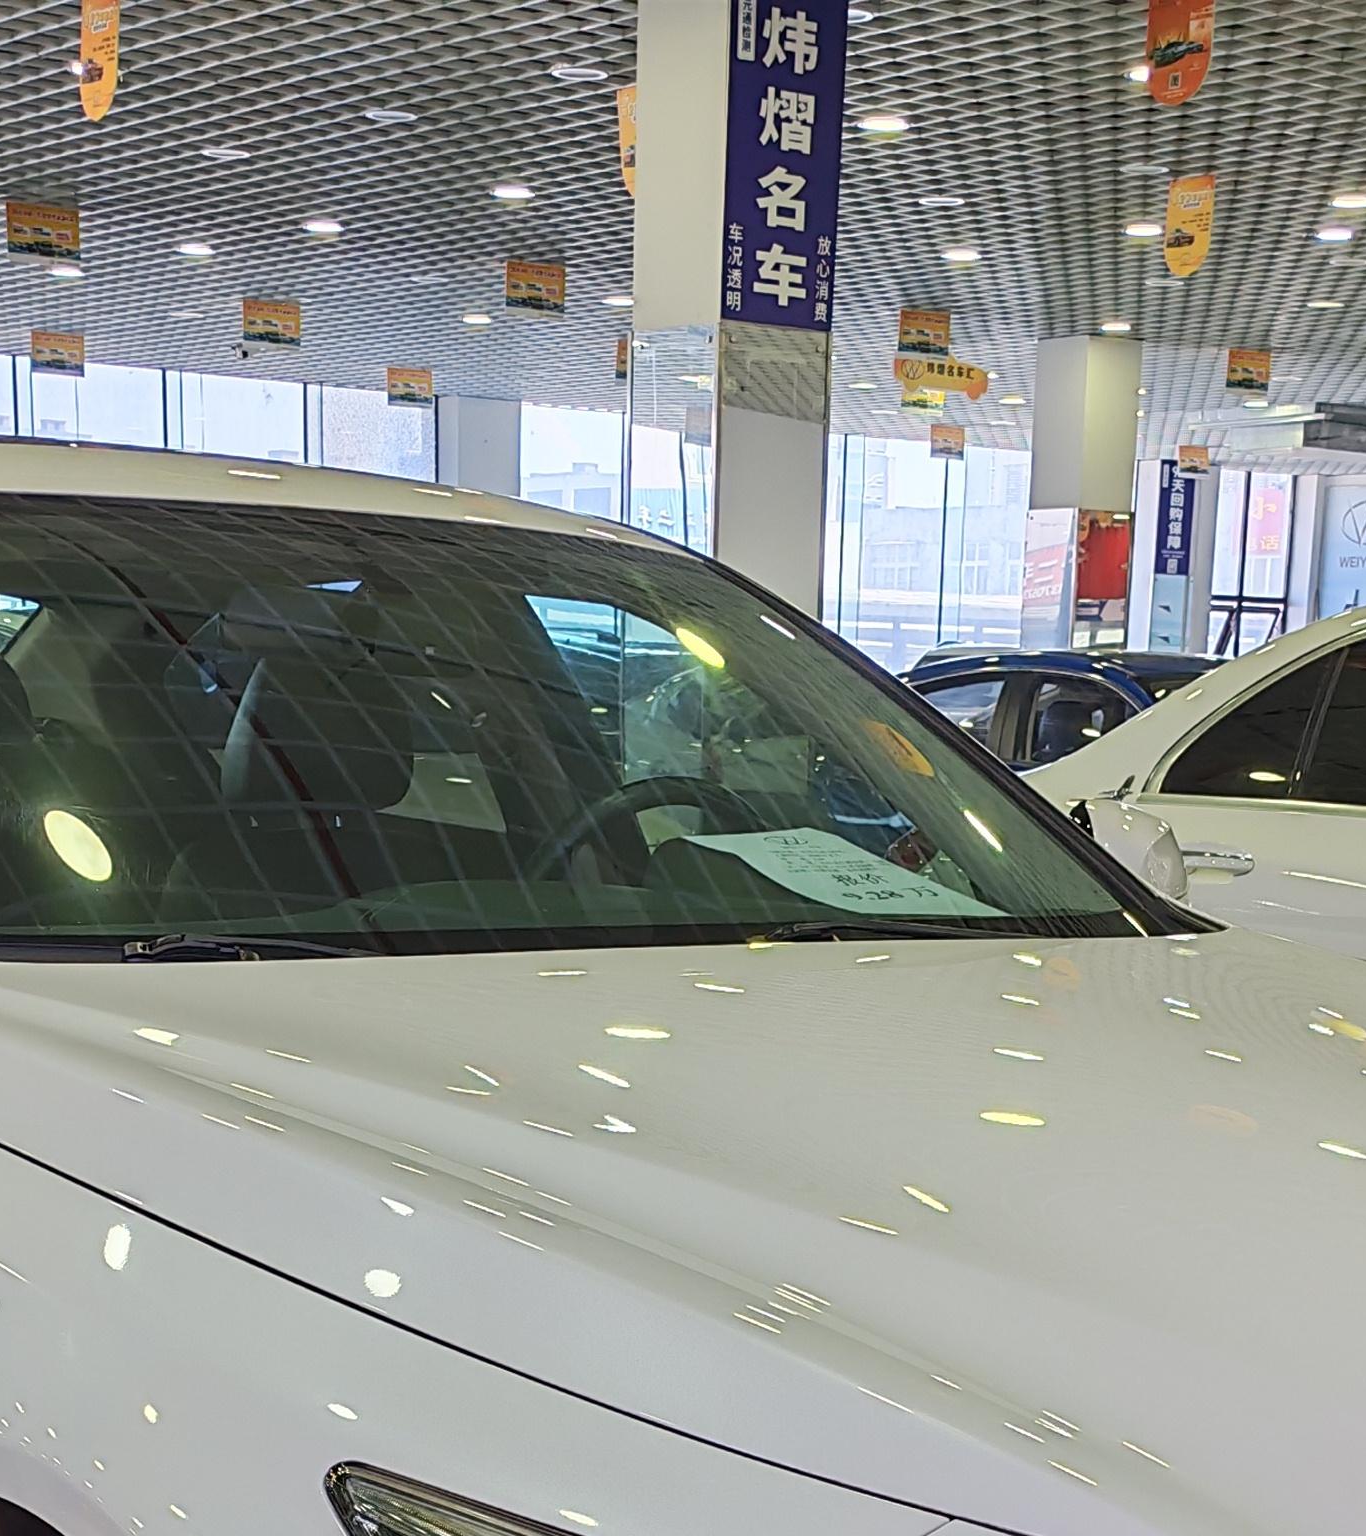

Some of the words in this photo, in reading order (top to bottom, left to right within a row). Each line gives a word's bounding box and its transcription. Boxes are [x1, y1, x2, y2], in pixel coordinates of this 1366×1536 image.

[753, 6, 819, 307] 炜熠名车
[726, 222, 744, 312] 车况透明
[814, 235, 832, 323] 放心消费
